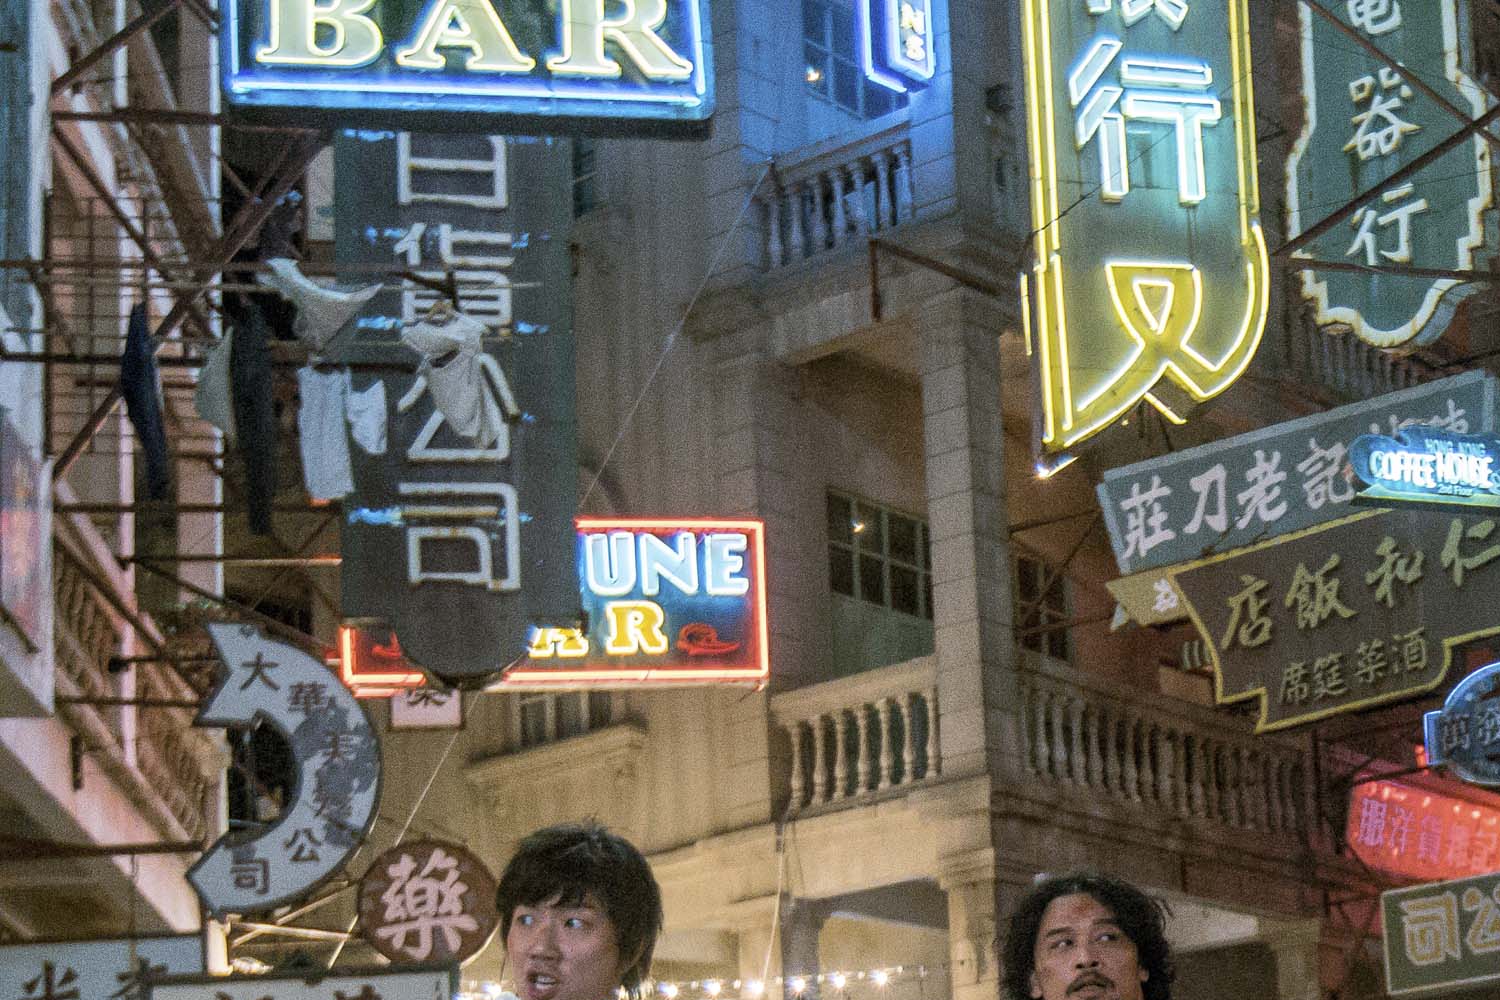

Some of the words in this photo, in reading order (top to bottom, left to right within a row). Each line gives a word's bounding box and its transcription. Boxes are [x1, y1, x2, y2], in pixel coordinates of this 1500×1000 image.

[256, 0, 694, 78] BAR
[1068, 0, 1222, 205] 行
[1369, 450, 1436, 489] COFFEE
[1436, 451, 1494, 489] HOUSE
[375, 847, 480, 961] 藥
